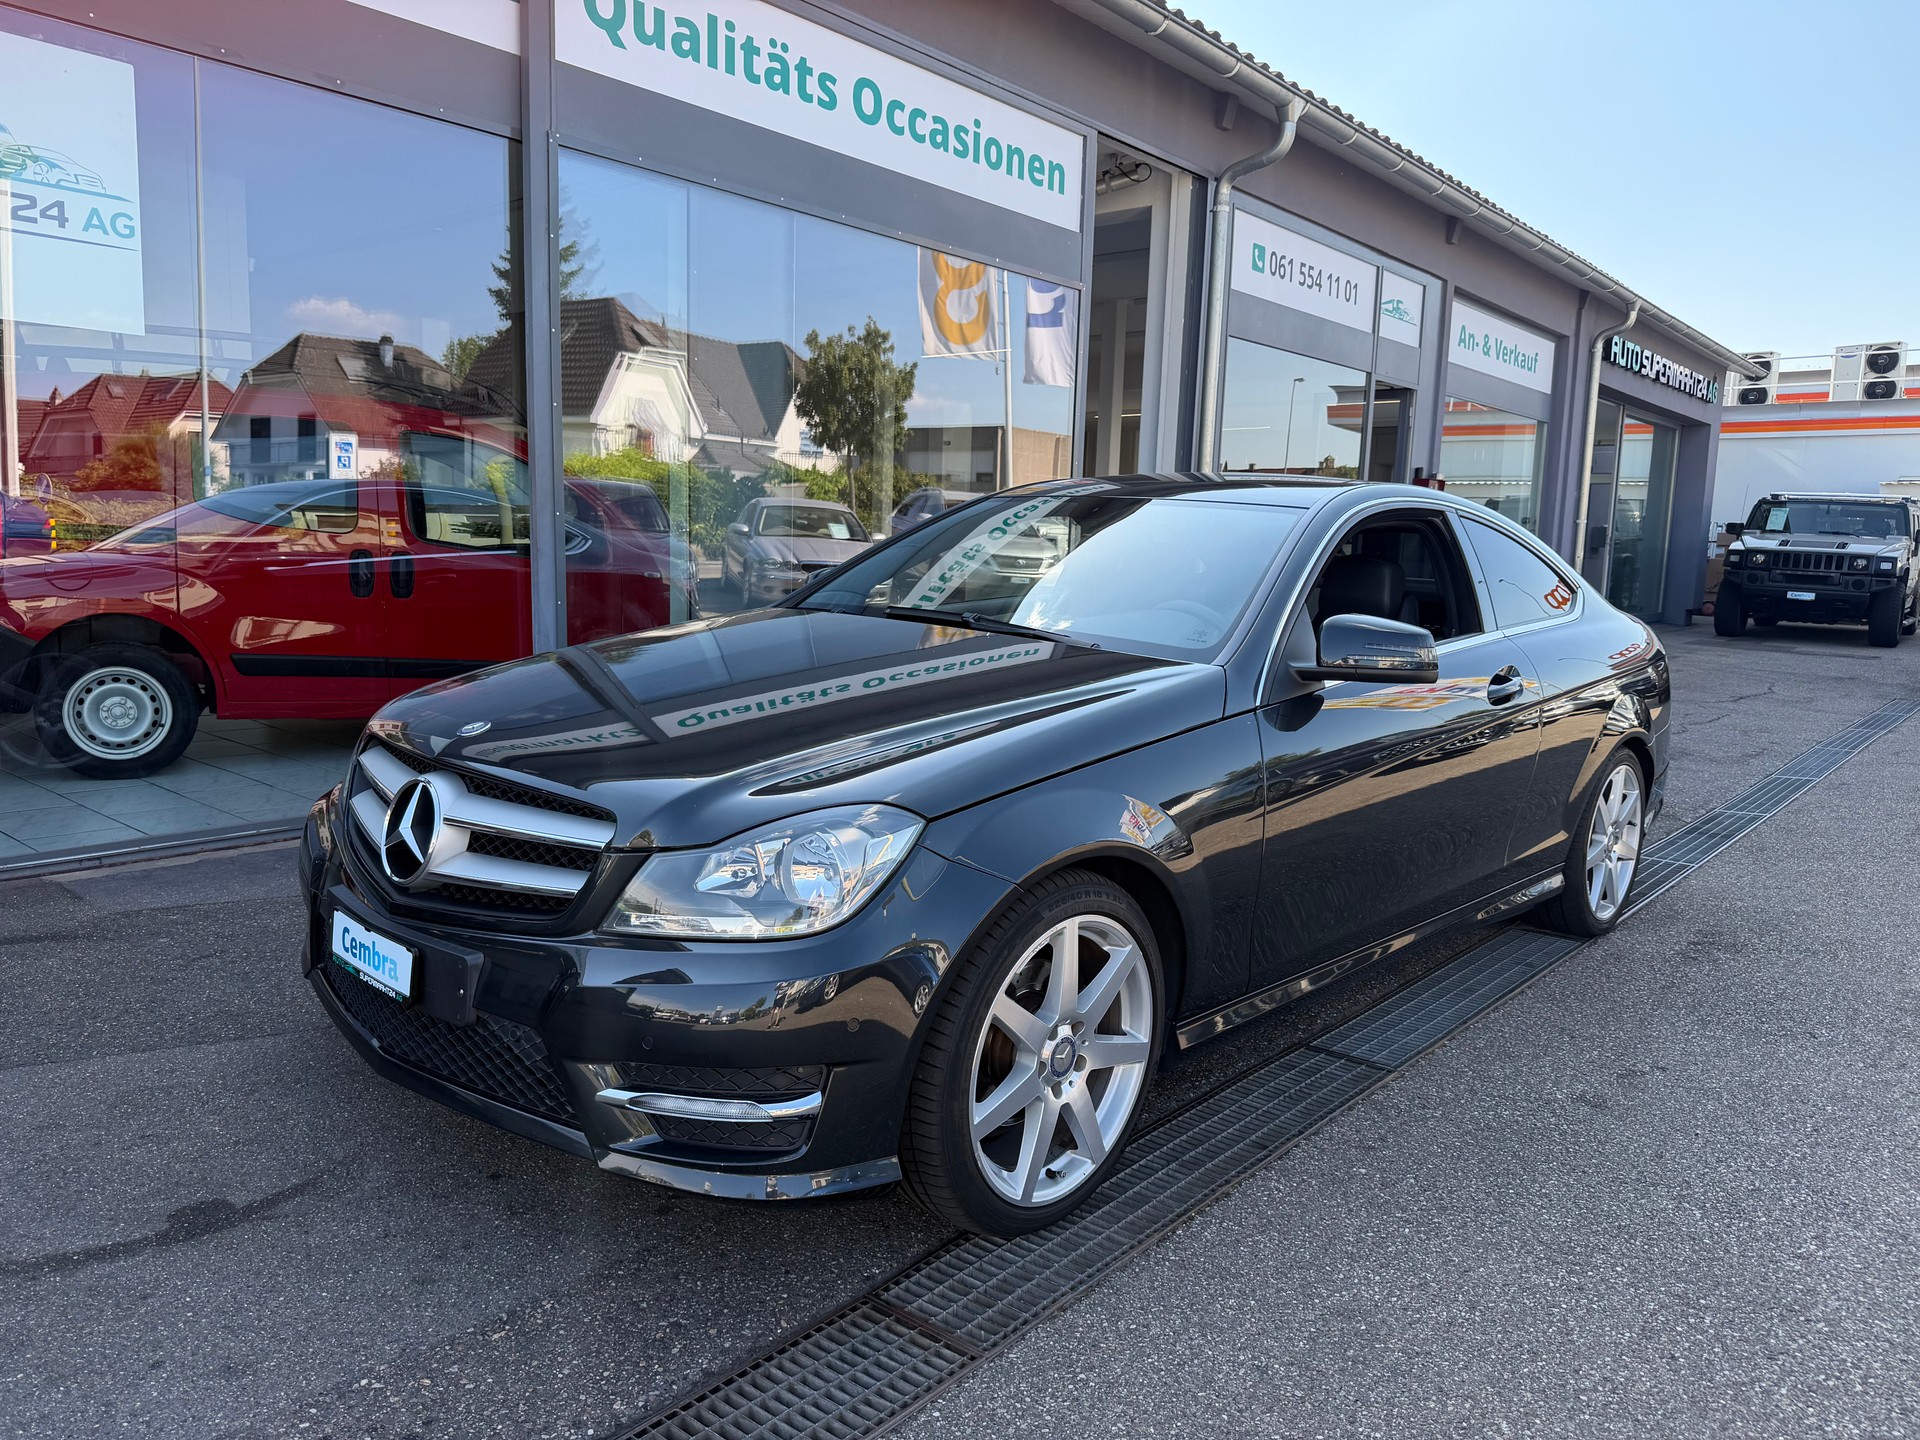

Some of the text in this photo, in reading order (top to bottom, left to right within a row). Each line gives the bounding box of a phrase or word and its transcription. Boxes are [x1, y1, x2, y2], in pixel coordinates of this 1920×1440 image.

[583, 0, 1066, 195] Qualitäts Occasionen
[0, 189, 136, 239] 24 AG
[1269, 250, 1359, 306] 061 554 11 01
[1457, 324, 1539, 374] An- & Verkauf
[1610, 335, 1719, 404] AUTO SUPERMARKT24 AG
[341, 926, 399, 982] Cembra
